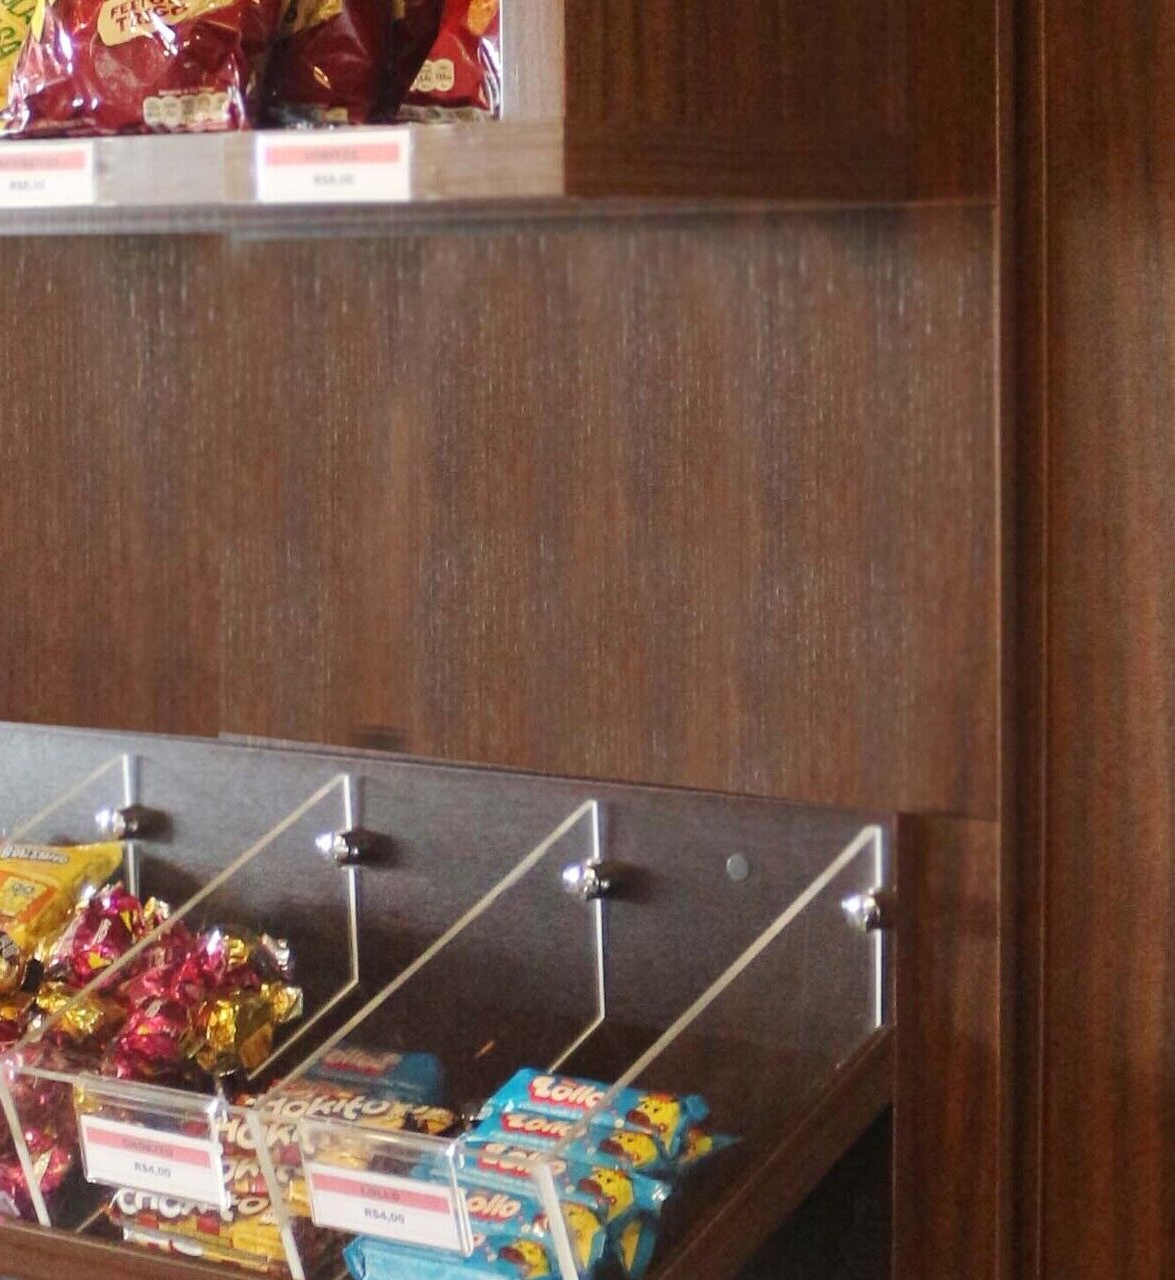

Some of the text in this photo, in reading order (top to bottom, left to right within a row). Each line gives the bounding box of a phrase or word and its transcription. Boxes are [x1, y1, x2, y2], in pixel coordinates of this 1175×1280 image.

[134, 1161, 172, 1178] R$4,00
[364, 1207, 406, 1225] R$4,00
[467, 1193, 521, 1221] ollo
